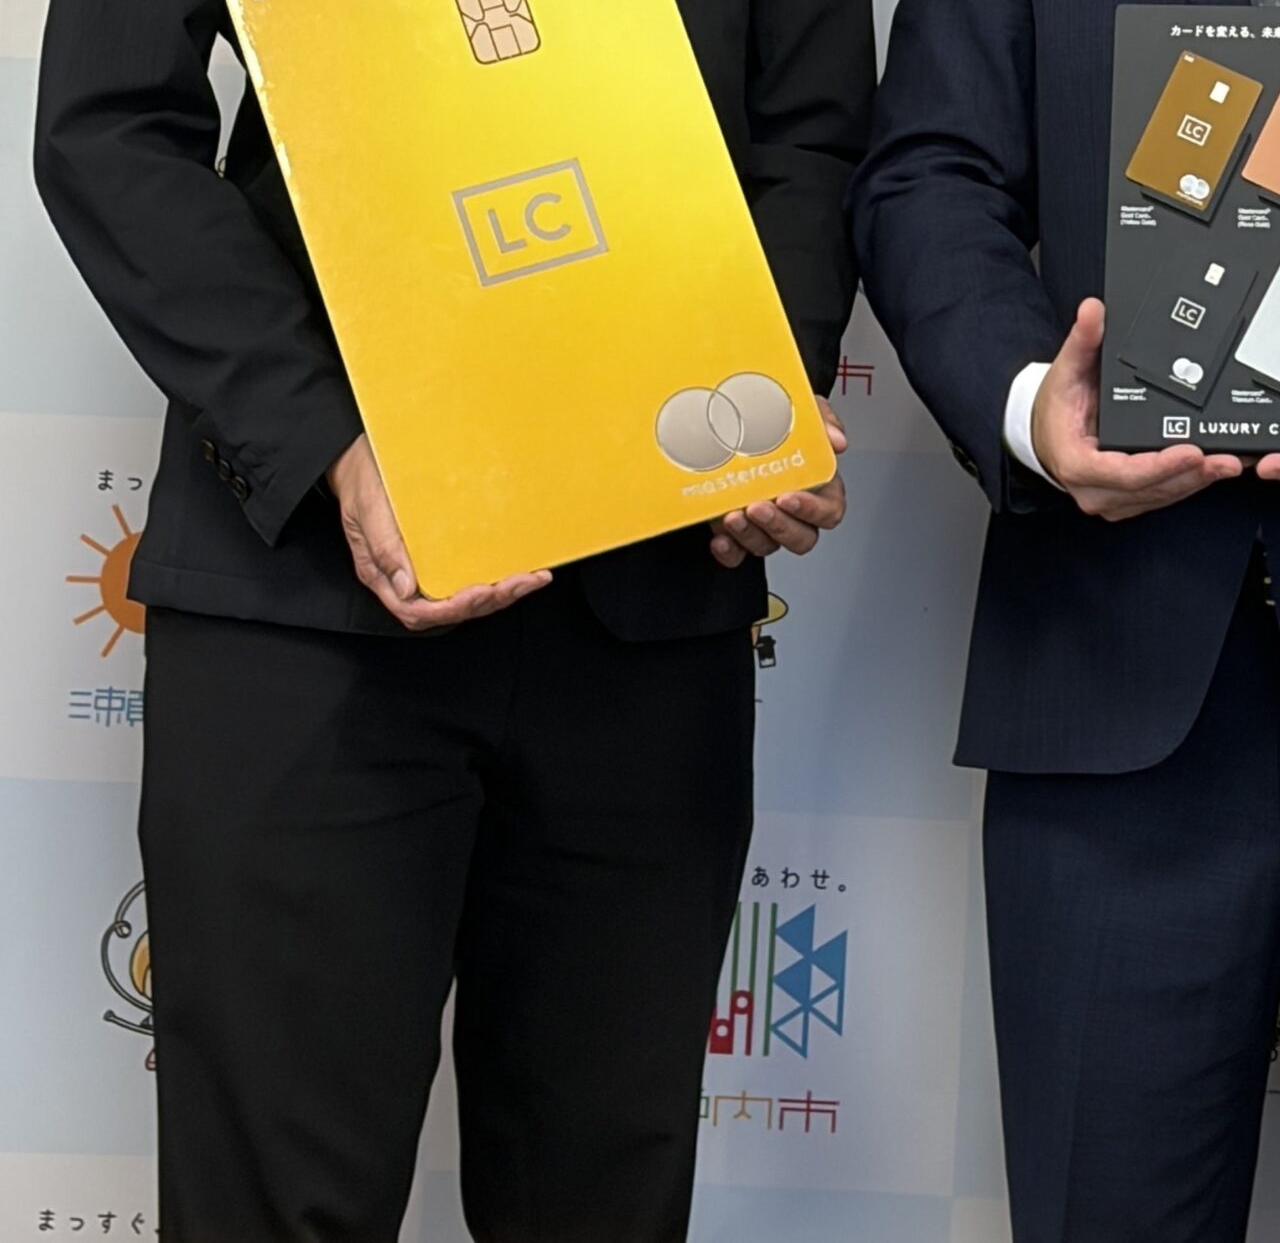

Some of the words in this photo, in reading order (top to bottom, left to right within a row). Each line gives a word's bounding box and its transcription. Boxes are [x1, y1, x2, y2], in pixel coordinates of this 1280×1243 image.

[487, 192, 572, 254] LC
[1199, 421, 1261, 435] LUXURY
[681, 448, 806, 498] mastercard
